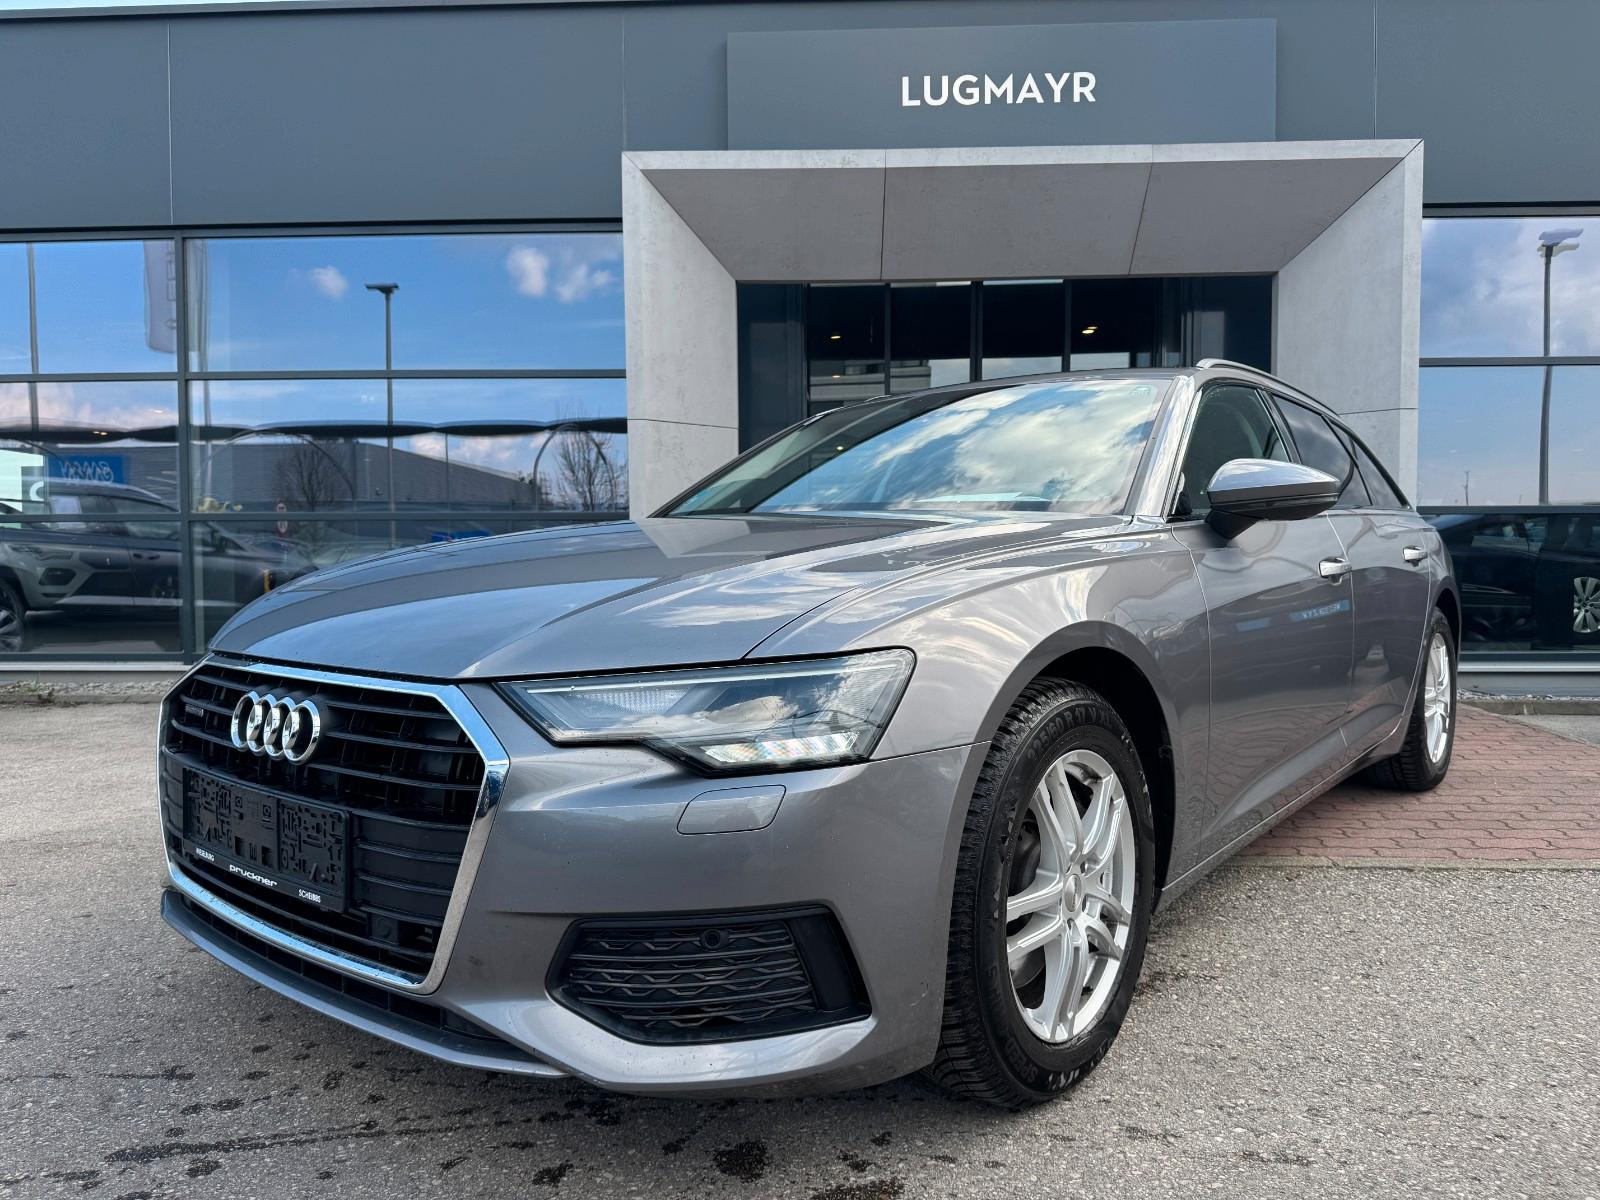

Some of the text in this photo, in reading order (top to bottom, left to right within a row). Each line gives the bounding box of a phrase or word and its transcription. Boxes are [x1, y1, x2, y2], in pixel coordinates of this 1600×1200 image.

[901, 71, 1097, 107] LUGMAYR
[1063, 711, 1075, 728] R
[229, 864, 278, 887] pruckner
